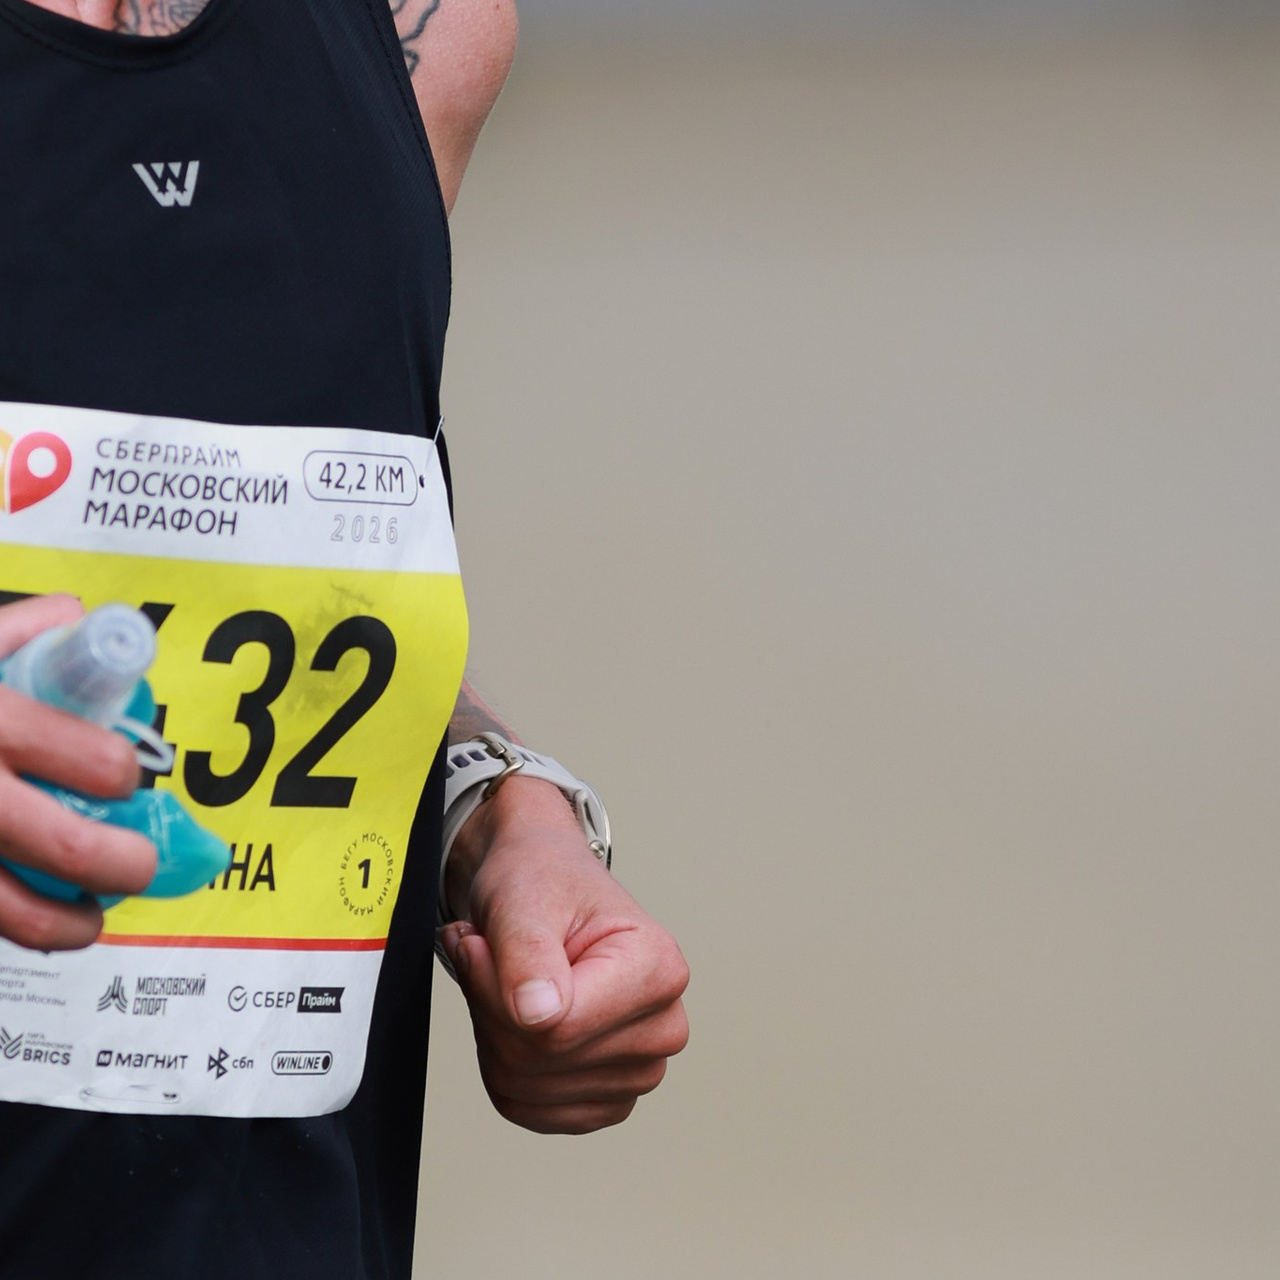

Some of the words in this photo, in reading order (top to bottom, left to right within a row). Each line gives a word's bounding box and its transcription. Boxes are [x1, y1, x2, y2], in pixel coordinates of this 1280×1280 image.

[96, 437, 242, 468] СБЕРПРАЙМ
[89, 466, 289, 505] МОСКОВСКИЙ
[319, 461, 367, 495] 42,2
[83, 500, 239, 536] МАРАФОН
[330, 514, 399, 544] 2026
[208, 842, 276, 892] НА
[340, 839, 358, 870] БЕГУ
[361, 832, 394, 907] МОСКОВСКИЙ
[357, 858, 372, 889] 1
[338, 875, 374, 916] МАРАФОН
[25, 992, 67, 1007] Москвы
[135, 973, 207, 997] МОСКОВСКИЙ
[252, 990, 296, 1010] СБЕР
[301, 991, 337, 1008] Прайм
[132, 997, 168, 1017] СПОРТ
[23, 1048, 71, 1066] BRICS
[232, 1056, 254, 1070] сбп
[275, 1055, 320, 1070] WINLINE
